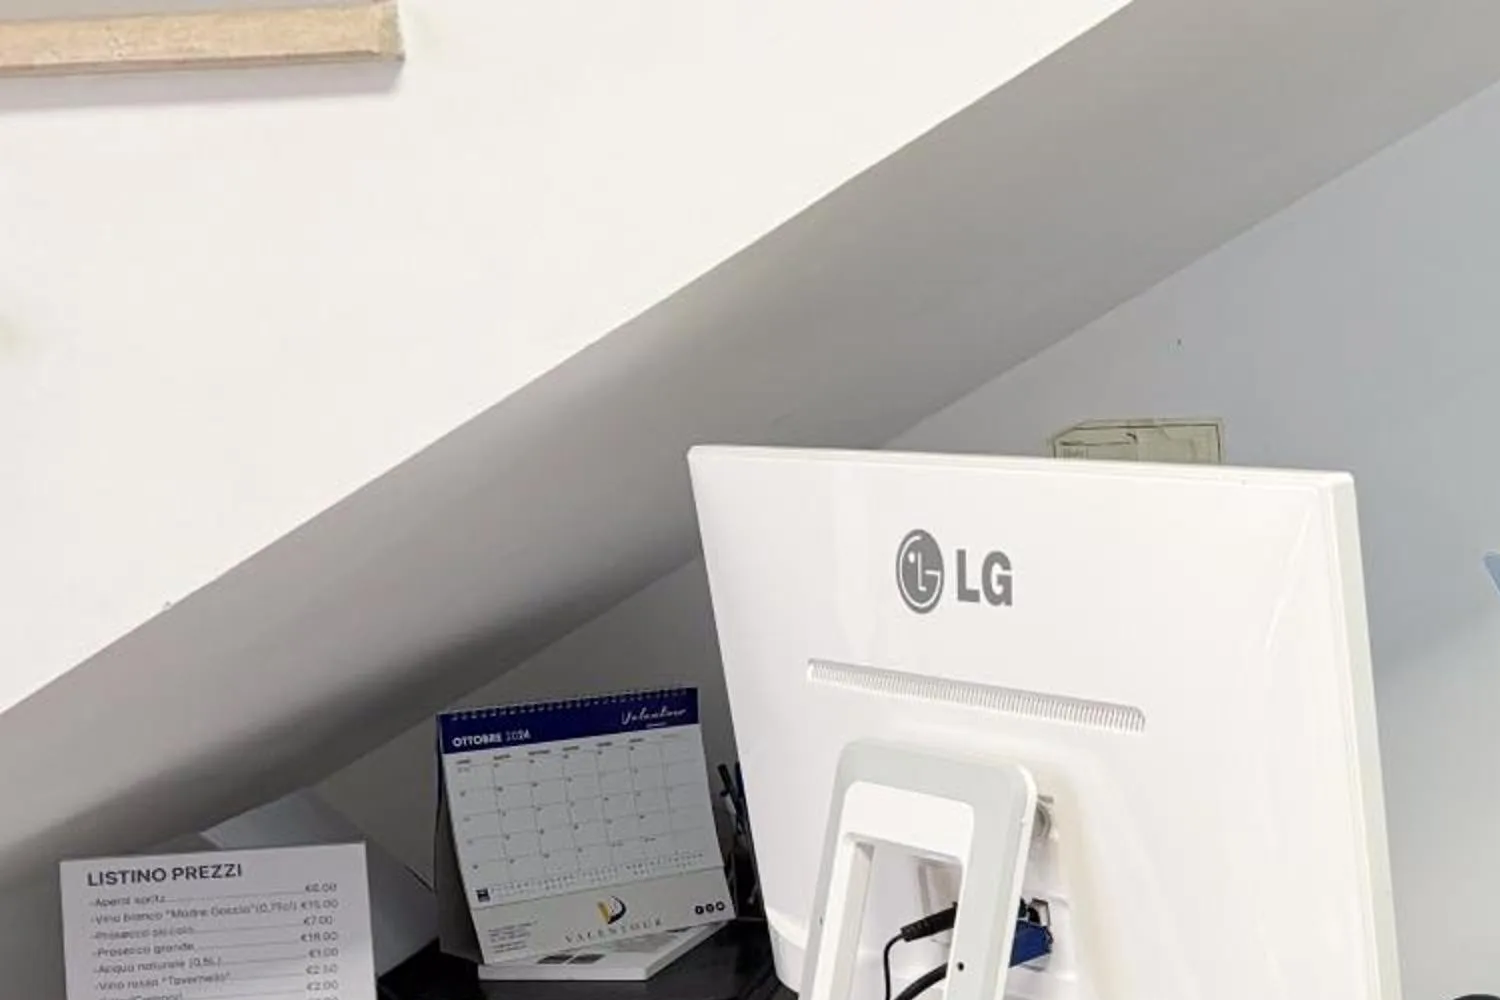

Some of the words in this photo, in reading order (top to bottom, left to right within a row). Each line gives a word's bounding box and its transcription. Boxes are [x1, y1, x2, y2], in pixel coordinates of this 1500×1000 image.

[956, 549, 1013, 606] LG
[452, 731, 503, 747] OTTOBRE
[88, 867, 167, 886] LISTINO
[171, 863, 242, 880] PREZZI
